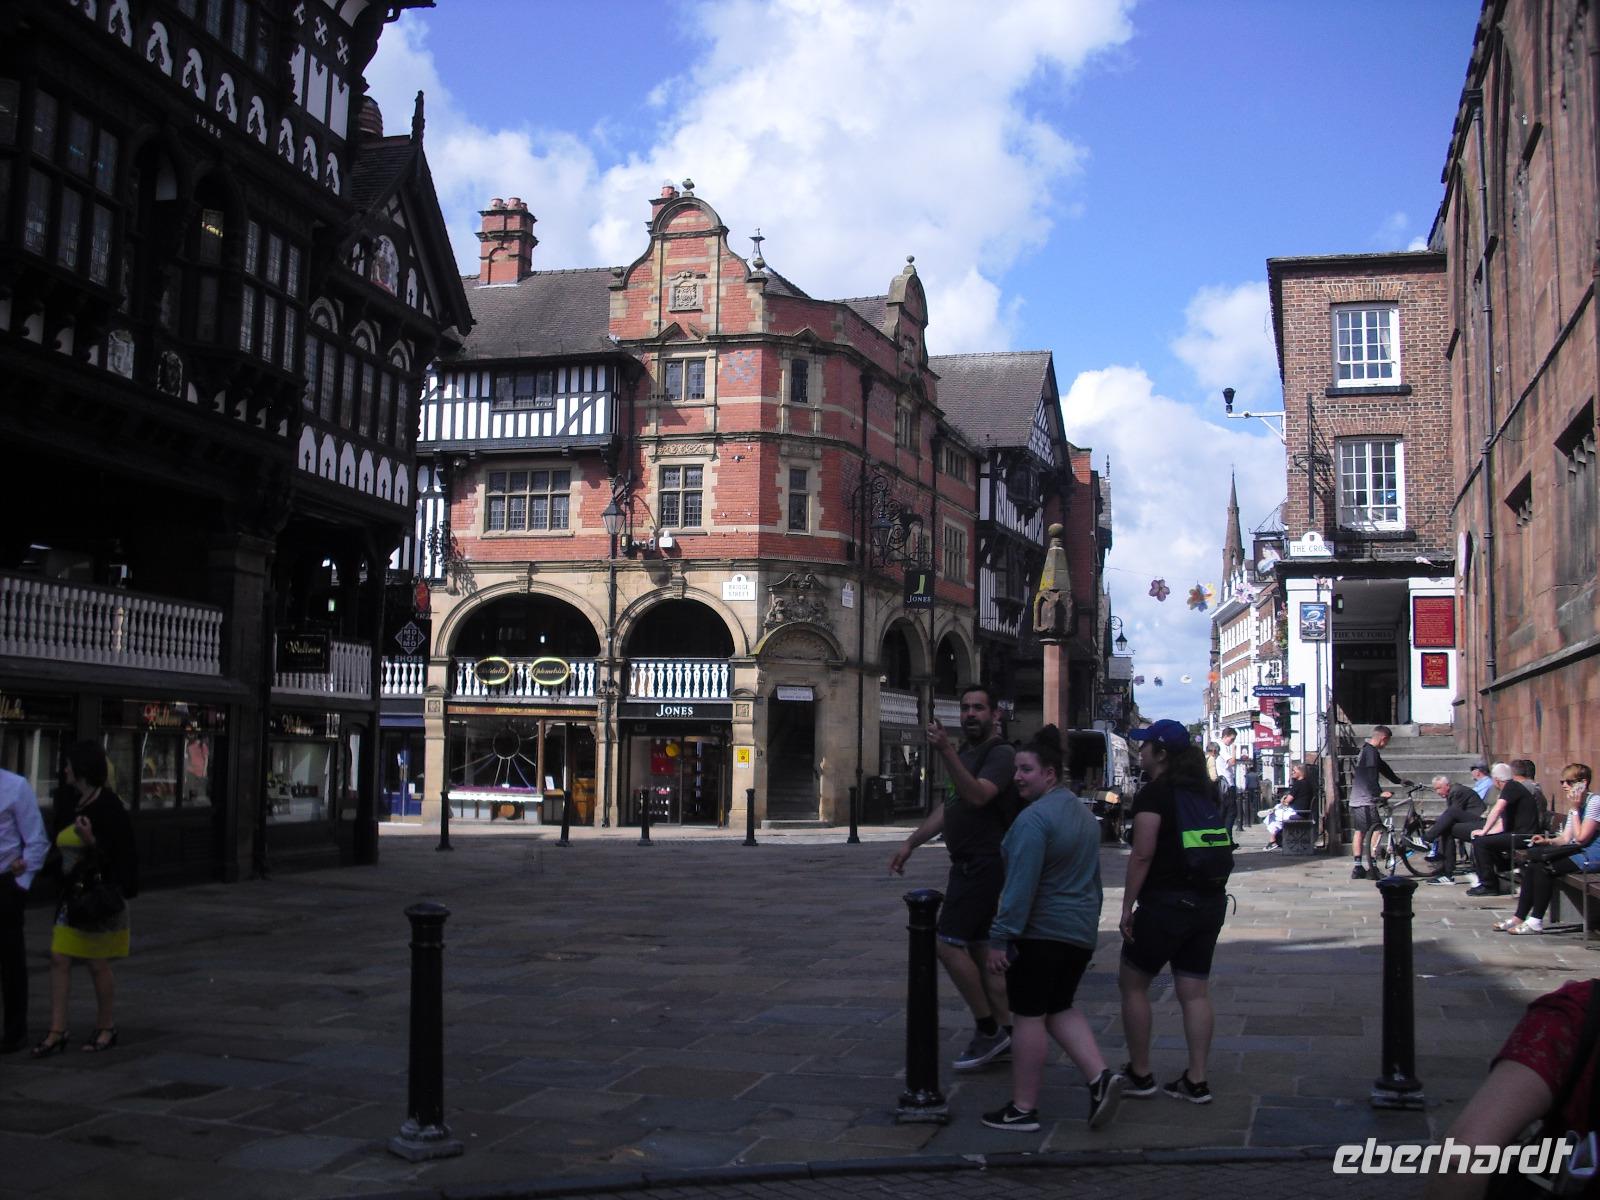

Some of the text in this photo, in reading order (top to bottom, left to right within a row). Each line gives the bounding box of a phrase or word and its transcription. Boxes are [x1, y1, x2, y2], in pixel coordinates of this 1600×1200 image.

[1292, 544, 1333, 553] THE CROSS
[906, 594, 931, 604] JONES
[394, 655, 424, 663] SHOES
[656, 704, 694, 717] JONES
